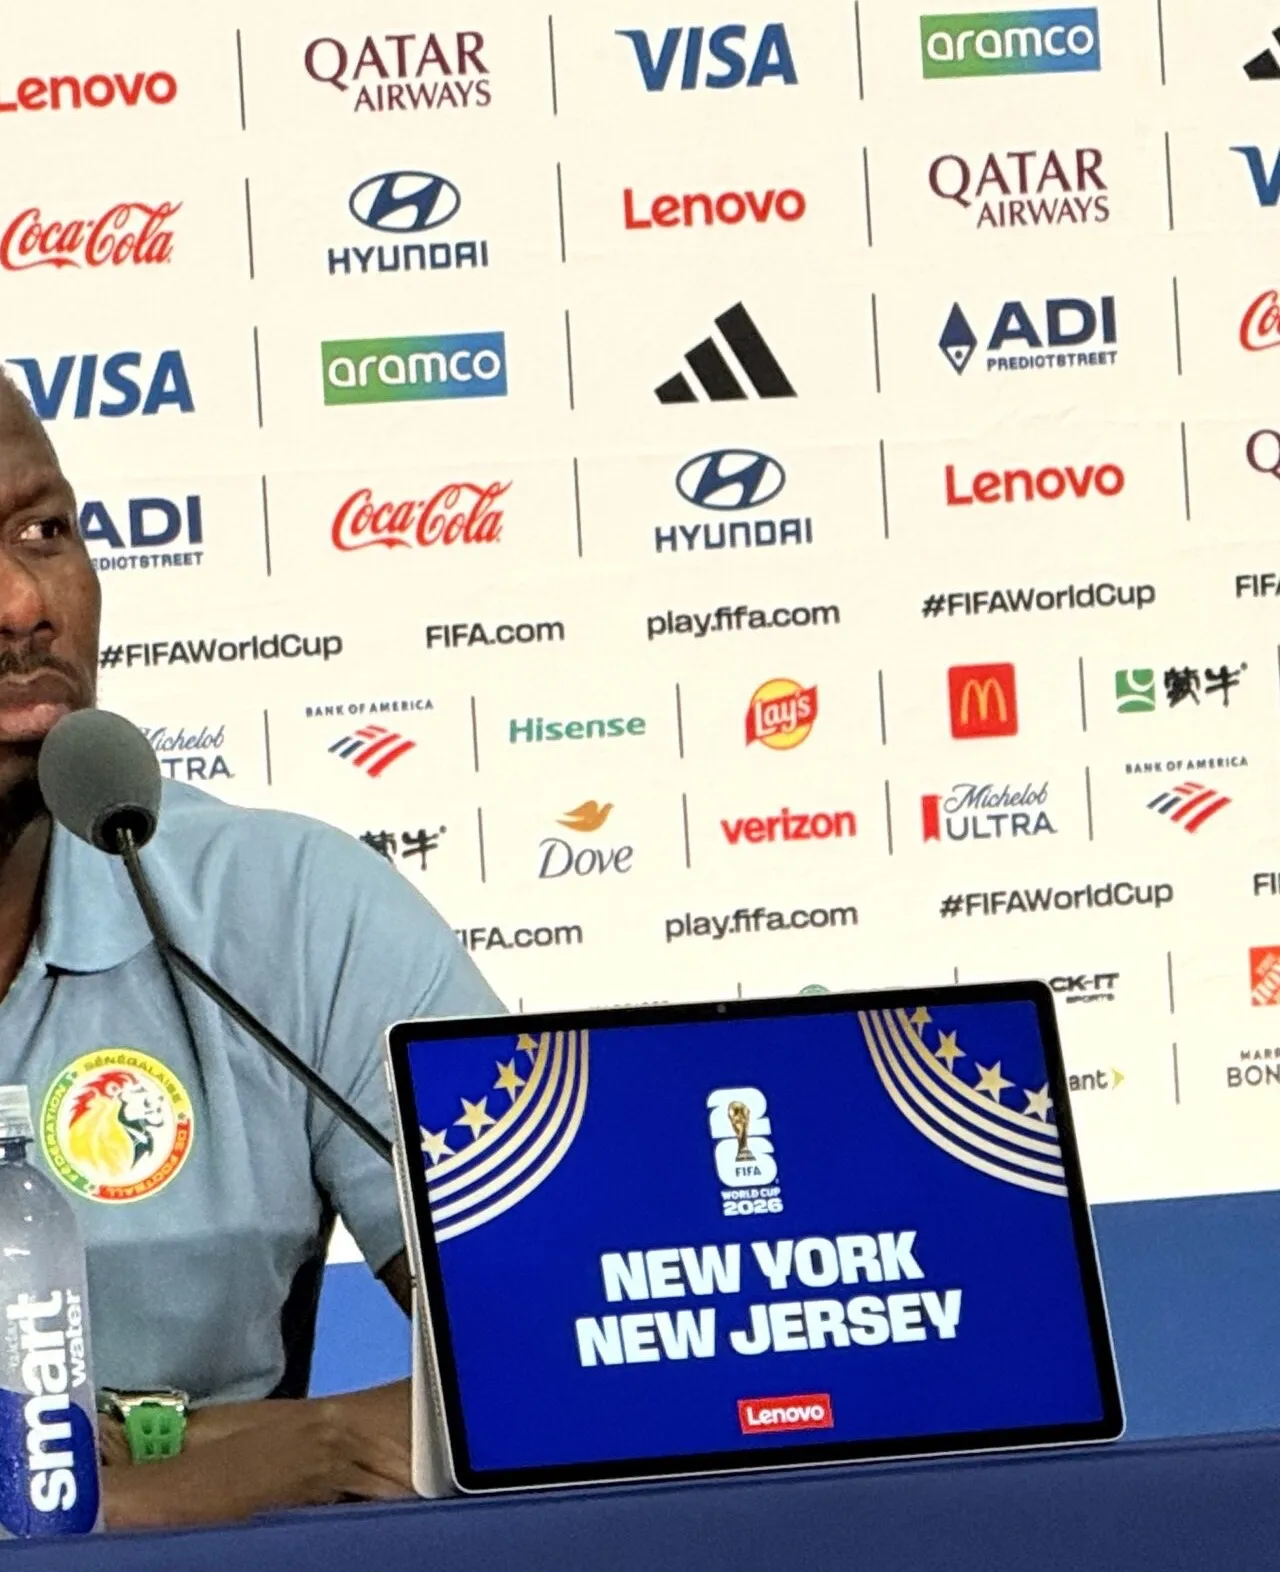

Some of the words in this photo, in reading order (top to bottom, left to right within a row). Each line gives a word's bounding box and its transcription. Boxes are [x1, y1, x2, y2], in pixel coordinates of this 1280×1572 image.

[614, 22, 799, 92] VISA
[926, 22, 1095, 62] aramco
[304, 31, 490, 92] QATAR
[353, 78, 492, 113] AIRWAYS
[928, 147, 1108, 208] QATAR
[623, 187, 807, 230] Lenovo
[976, 195, 1110, 229] AIRWAYS
[327, 240, 489, 275] HYUNDAI
[986, 295, 1117, 351] ADI
[5, 350, 195, 420] VISA
[326, 348, 503, 390] aramco
[944, 463, 1125, 507] Lenovo
[78, 494, 204, 549] ADI
[331, 481, 512, 553] Coca-Cola
[654, 517, 813, 554] HYUNDAI
[921, 582, 1156, 619] #FIFAWorldCup
[425, 621, 565, 649] FIFA.com
[646, 604, 841, 641] play.fifa.com
[100, 628, 343, 670] #FIFAWorldCup
[304, 705, 344, 718] BANK
[348, 702, 365, 716] OF
[369, 699, 434, 715] AMERICA
[509, 717, 646, 743] Hisense
[161, 755, 231, 781] TRA
[1124, 762, 1163, 776] BANK
[1166, 761, 1184, 773] OF
[1186, 755, 1249, 772] AMERICA
[944, 781, 1049, 814] Michelob
[720, 807, 857, 846] verizon
[945, 811, 1058, 841] ULTRA
[538, 837, 634, 879] Dove
[939, 881, 1174, 919] #FIFAWorldCup
[453, 923, 583, 953] IFA.com
[665, 906, 859, 944] play.fifa.com
[1049, 972, 1120, 993] CK-IT
[735, 1166, 762, 1177] FIFA
[721, 1189, 759, 1200] WORLD
[760, 1187, 781, 1198] CUP
[723, 1198, 784, 1216] 2026
[601, 1243, 740, 1303] NEW
[751, 1230, 925, 1290] YORK
[66, 1289, 87, 1387] water
[575, 1308, 716, 1367] NEW
[730, 1290, 962, 1357] JERSEY
[6, 1290, 78, 1513] smart
[746, 1402, 825, 1428] Lenovo
